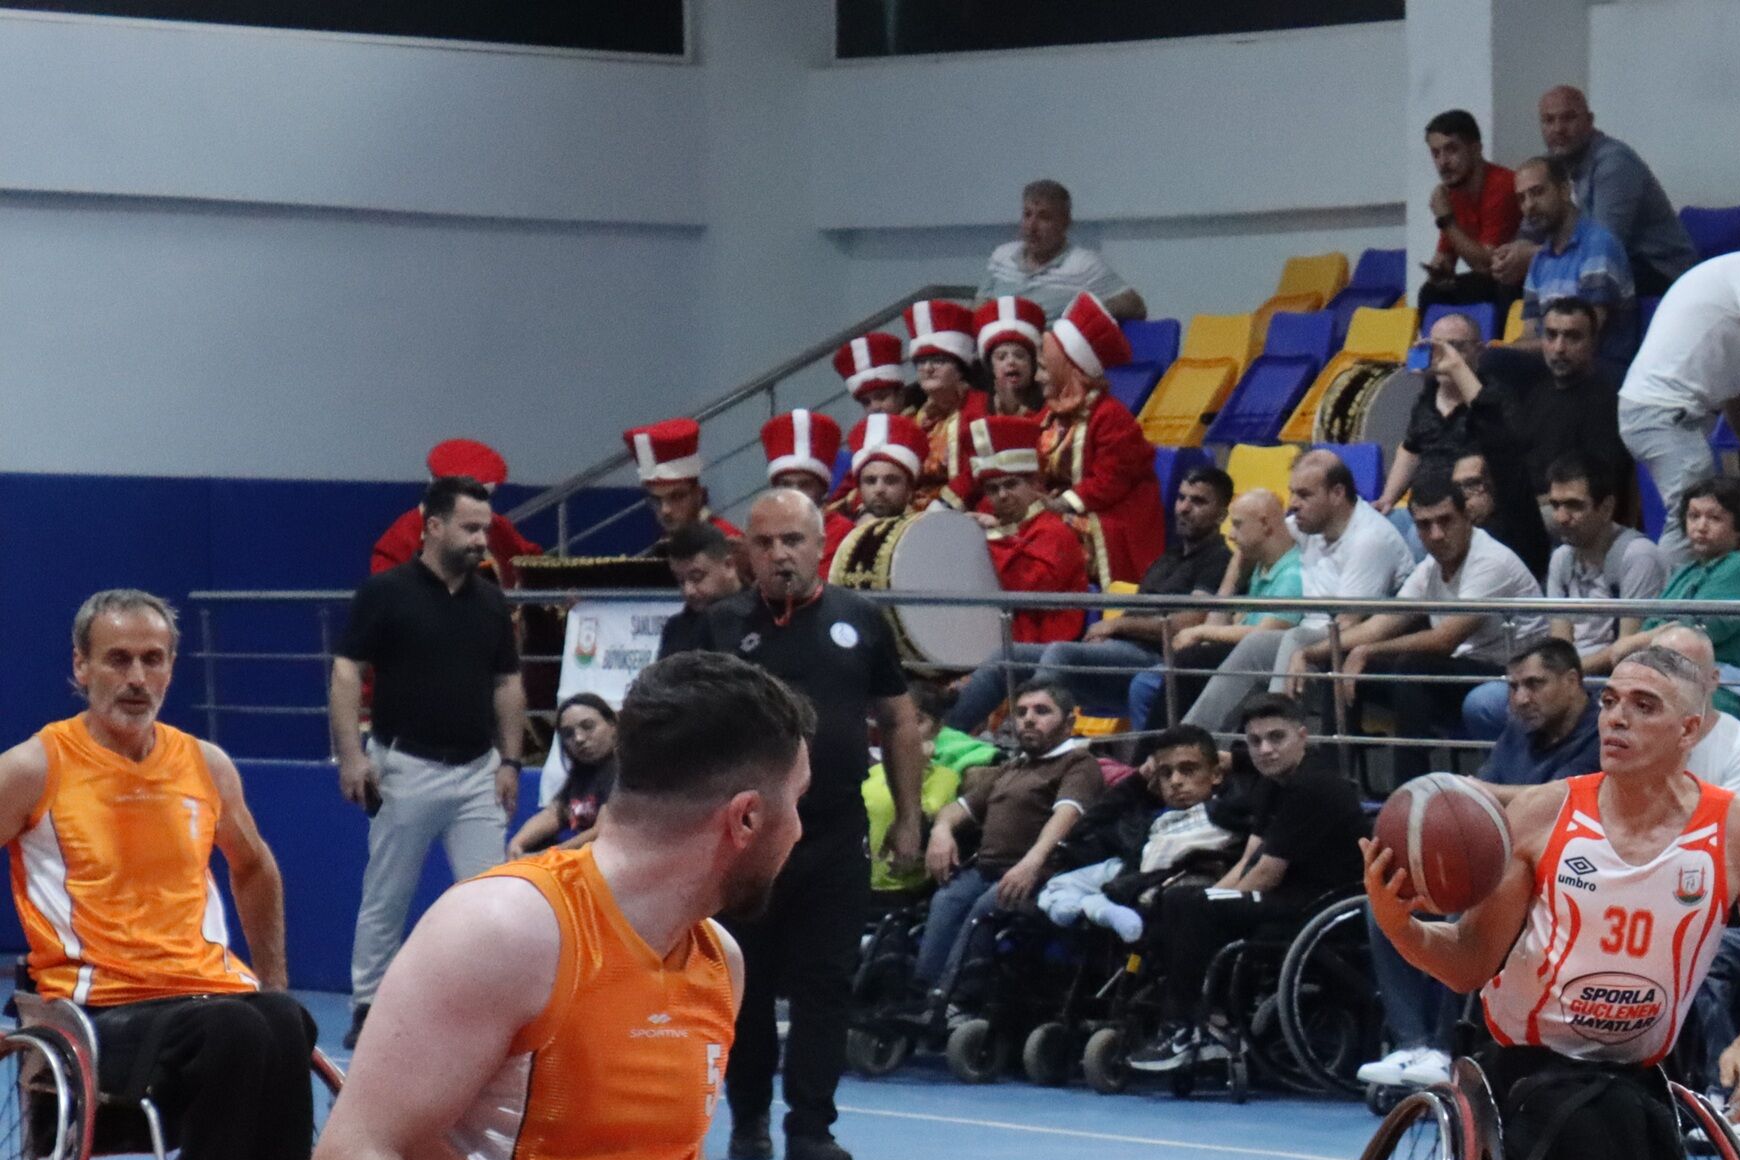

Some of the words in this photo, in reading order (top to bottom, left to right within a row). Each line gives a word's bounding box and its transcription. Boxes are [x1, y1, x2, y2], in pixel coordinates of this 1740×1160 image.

[1558, 873, 1597, 892] umbro
[1600, 904, 1654, 959] 30
[1580, 987, 1655, 1004] SPORLA
